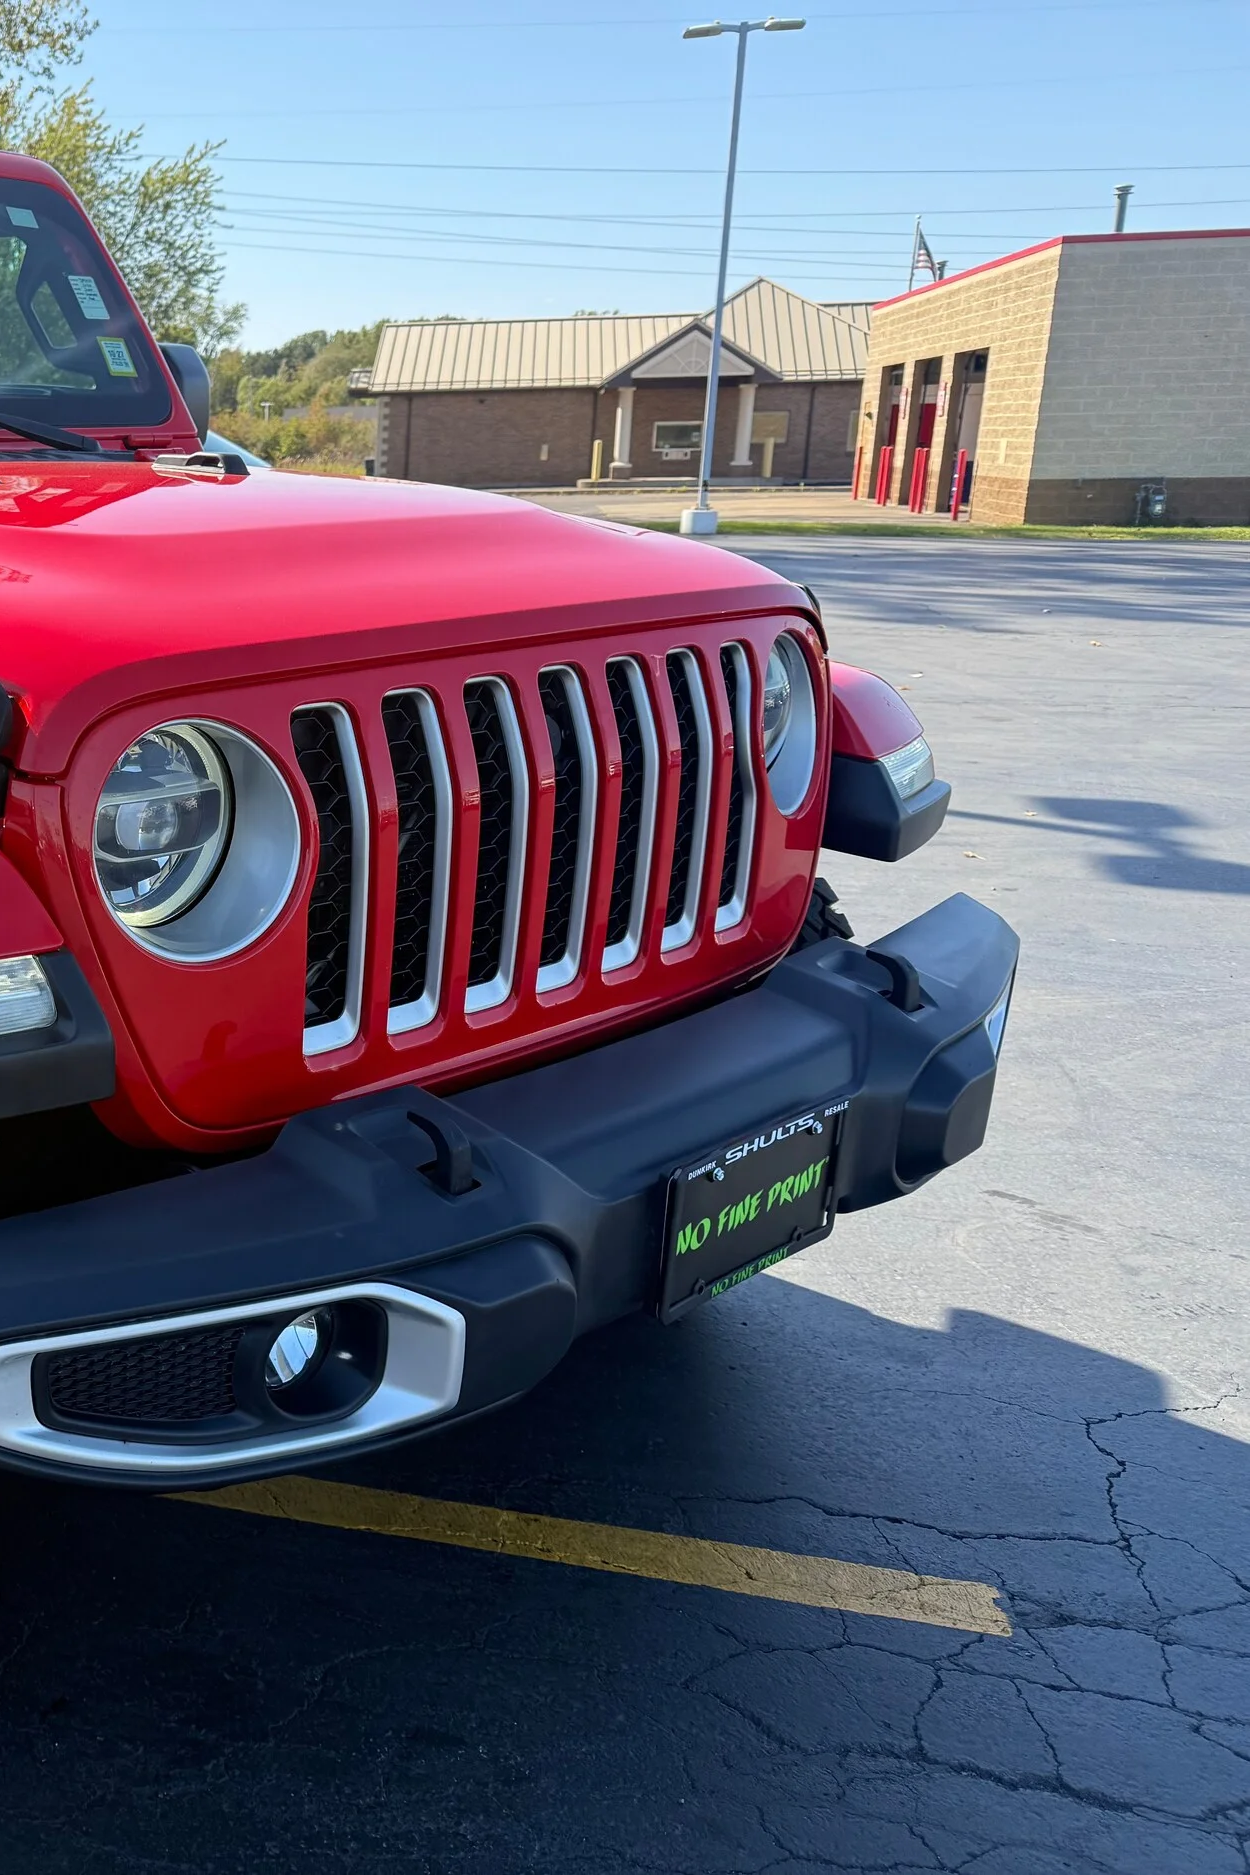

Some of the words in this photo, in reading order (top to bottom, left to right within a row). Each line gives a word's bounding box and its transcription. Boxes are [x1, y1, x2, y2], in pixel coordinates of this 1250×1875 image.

[687, 1161, 717, 1181] DUNKIRK
[725, 1113, 815, 1165] SHULTS
[824, 1100, 849, 1117] RESALE
[676, 1218, 711, 1256] NO
[717, 1189, 764, 1237] FINE
[766, 1158, 825, 1212] PRINT
[711, 1278, 729, 1298] NO
[732, 1264, 754, 1284] FINE
[757, 1245, 789, 1271] PRINT
